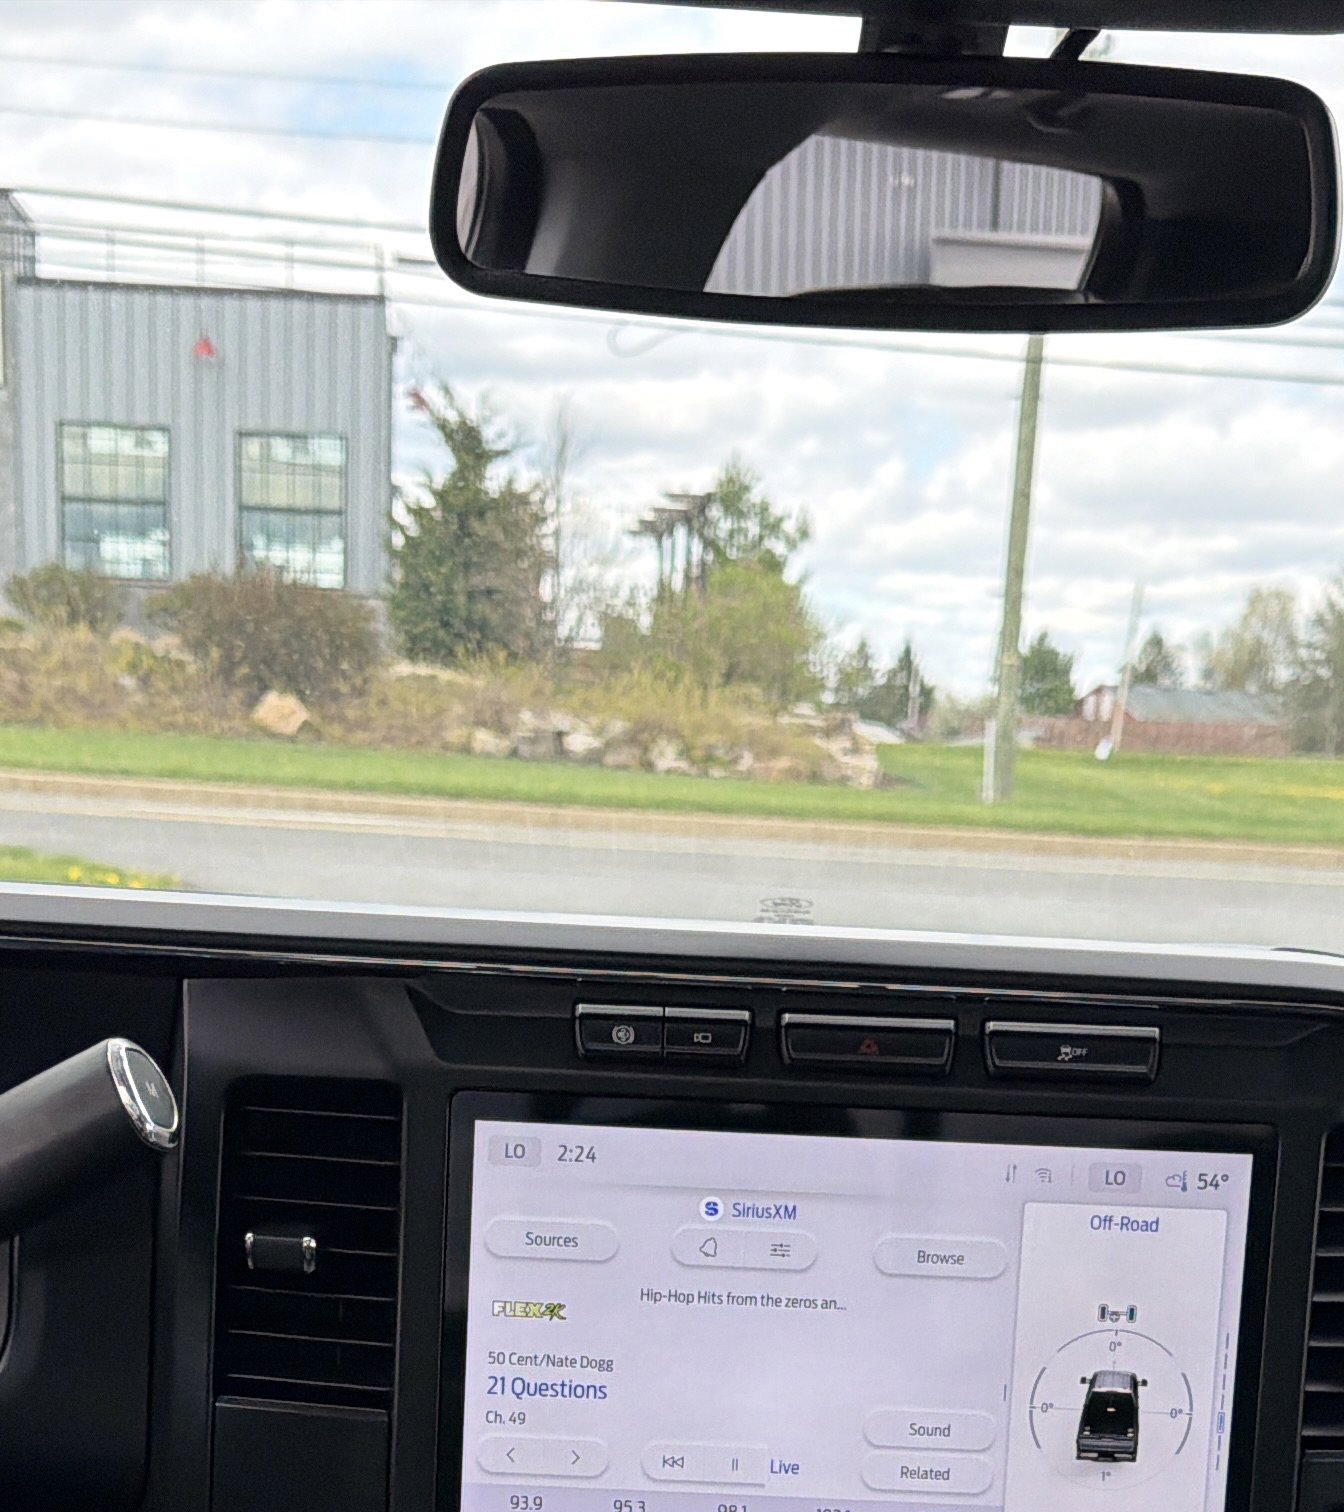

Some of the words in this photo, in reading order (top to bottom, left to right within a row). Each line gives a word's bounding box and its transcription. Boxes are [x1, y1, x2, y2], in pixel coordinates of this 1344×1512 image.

[1072, 1047, 1088, 1056] OFF
[504, 1143, 526, 1160] LO
[557, 1144, 597, 1164] 2:24
[1104, 1170, 1126, 1186] LO
[1196, 1172, 1230, 1191] 54°
[731, 1202, 797, 1221] SiriusXM
[1089, 1215, 1160, 1234] Off-Road
[524, 1231, 579, 1249] Sources
[916, 1250, 965, 1266] Browse
[639, 1287, 695, 1307] Hip-Hop
[697, 1289, 724, 1306] Hits
[726, 1291, 758, 1308] from
[760, 1292, 782, 1308] the
[784, 1296, 818, 1311] zeros
[487, 1351, 506, 1366] 50
[508, 1352, 578, 1369] Cent/Nate
[580, 1356, 614, 1373] Dogg
[486, 1375, 506, 1395] 21
[510, 1376, 608, 1401] Questions
[485, 1410, 506, 1425] Ch.
[508, 1411, 527, 1426] 49
[908, 1422, 951, 1438] Sound
[770, 1458, 800, 1476] Live
[899, 1466, 951, 1482] Related
[509, 1495, 543, 1512] 93.9
